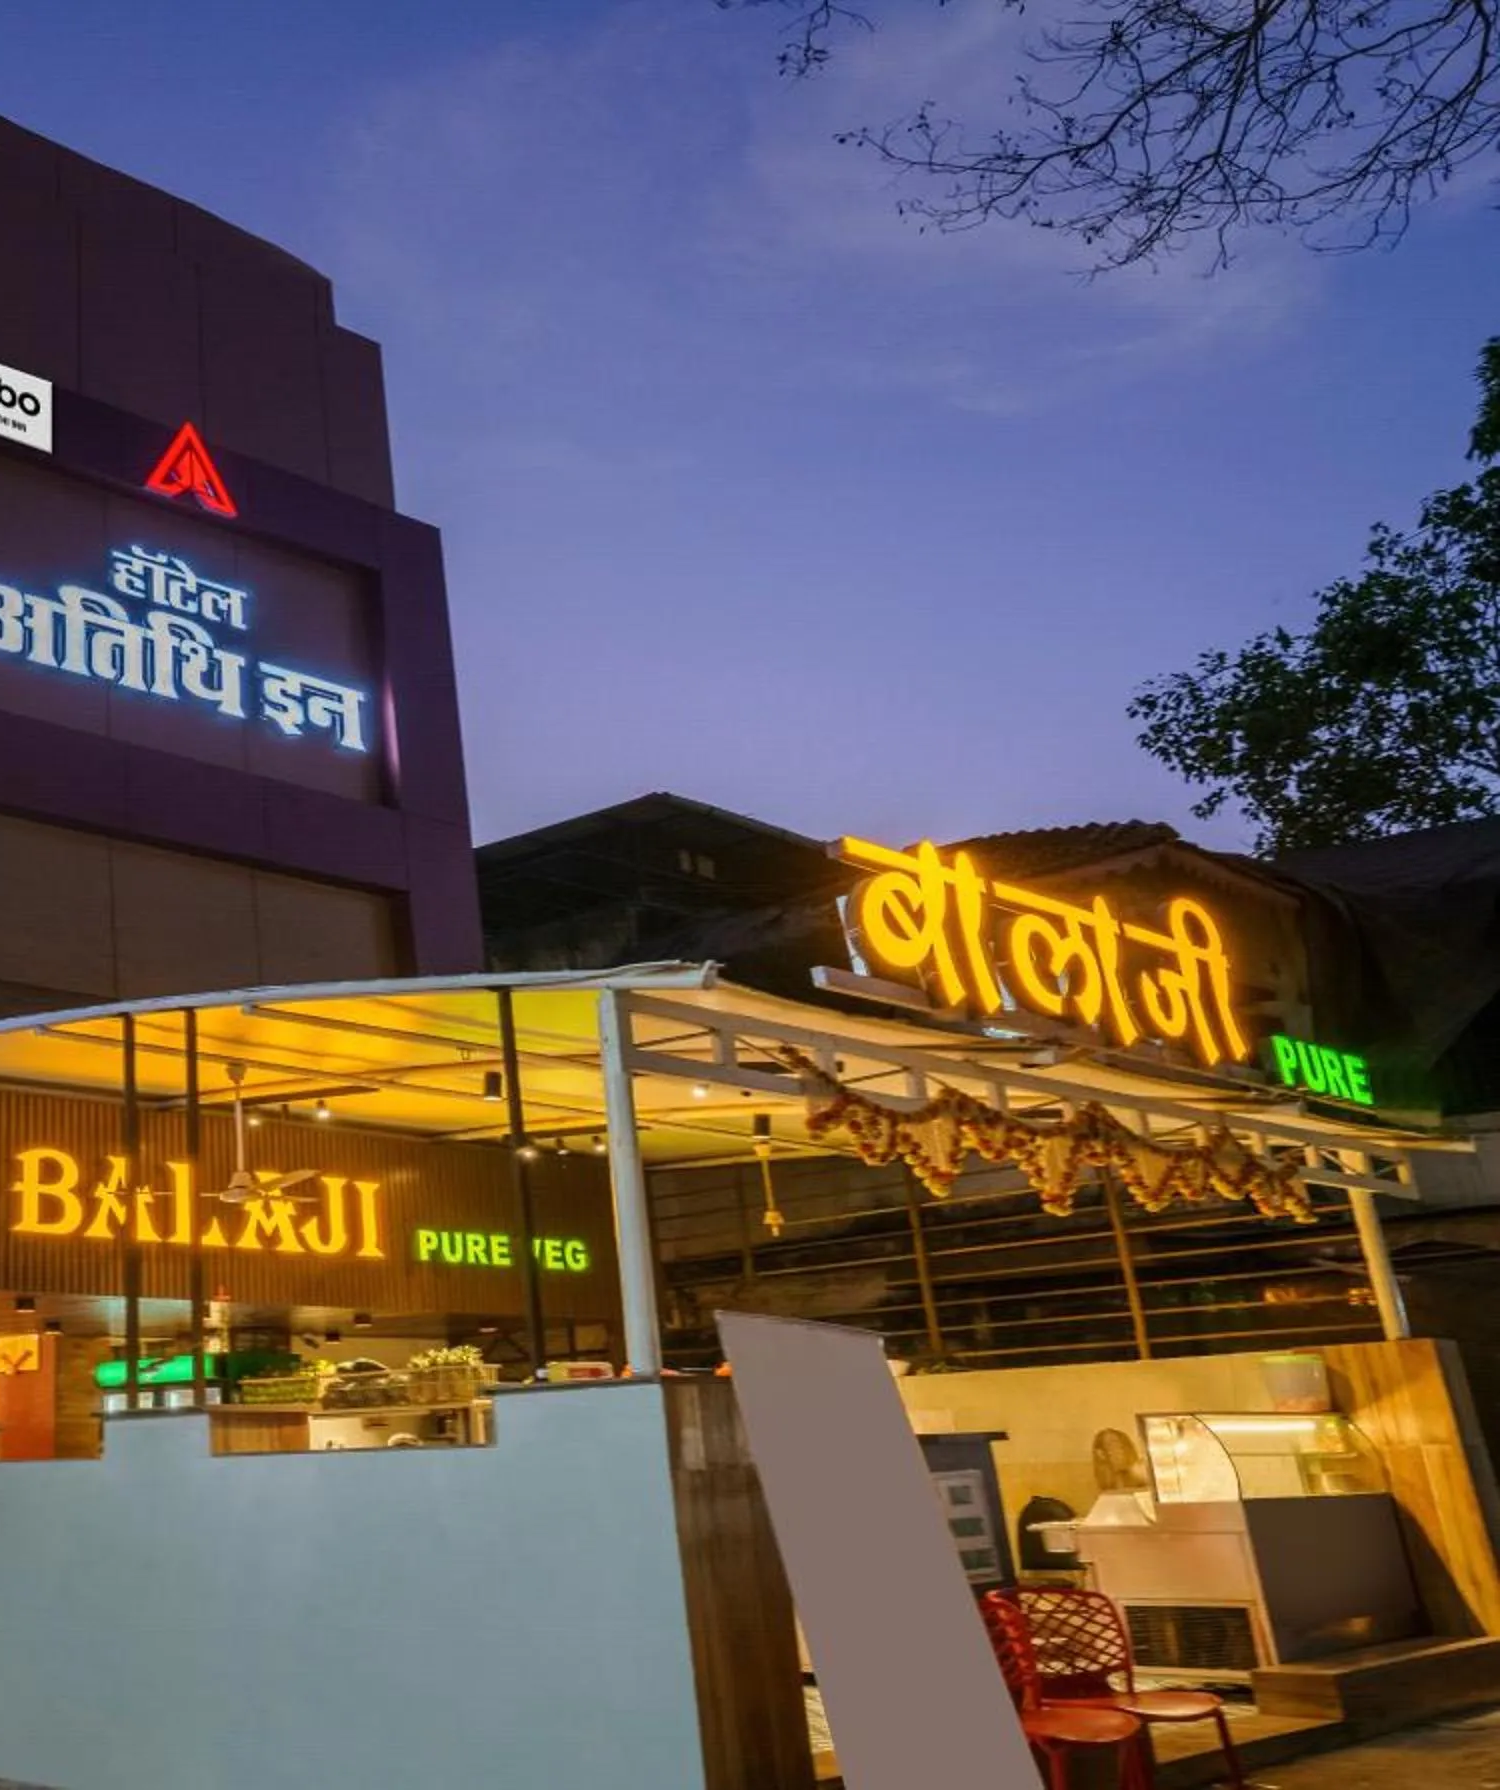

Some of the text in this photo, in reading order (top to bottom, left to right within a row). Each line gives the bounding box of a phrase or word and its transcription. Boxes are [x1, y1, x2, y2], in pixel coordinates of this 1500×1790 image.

[258, 661, 367, 753] इन
[1270, 1034, 1374, 1106] PURE
[9, 1148, 385, 1259] BALAJI
[417, 1229, 512, 1267] PURE
